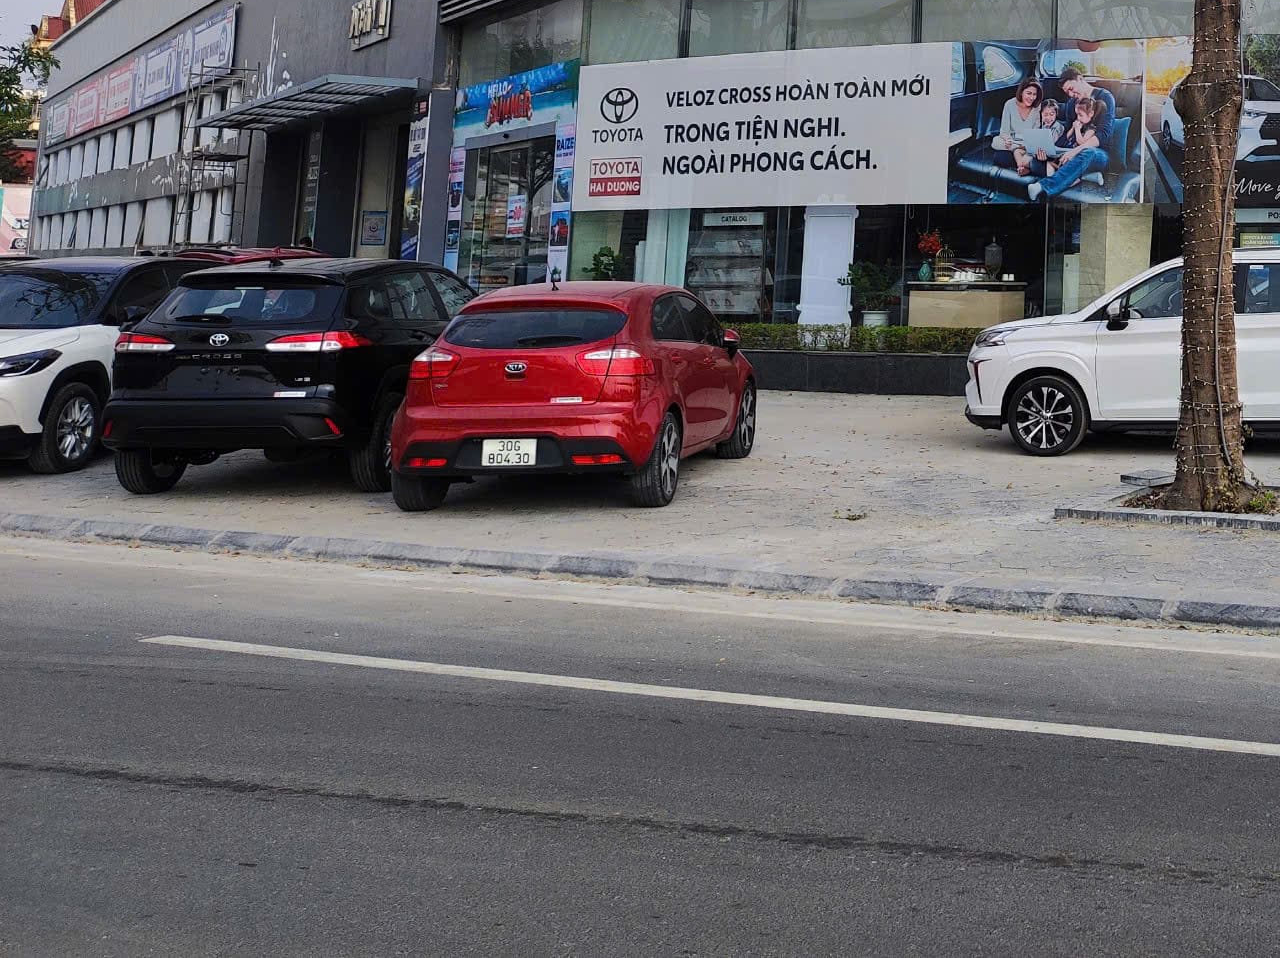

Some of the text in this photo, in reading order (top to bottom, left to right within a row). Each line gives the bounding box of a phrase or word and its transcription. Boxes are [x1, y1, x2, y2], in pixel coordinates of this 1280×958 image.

[666, 74, 931, 108] VELOZ CROSS HOÀN TOÀN MỚI
[592, 128, 643, 143] TOYOTA
[664, 115, 846, 146] TRONG TIỆN NGHI.
[662, 145, 878, 175] NGOÀI PHONG CÁCH.
[592, 161, 640, 176] TOYOTA
[1234, 177, 1274, 196] Move
[721, 215, 747, 223] CATALOG
[498, 440, 521, 452] 30G
[488, 452, 530, 465] 804.30
